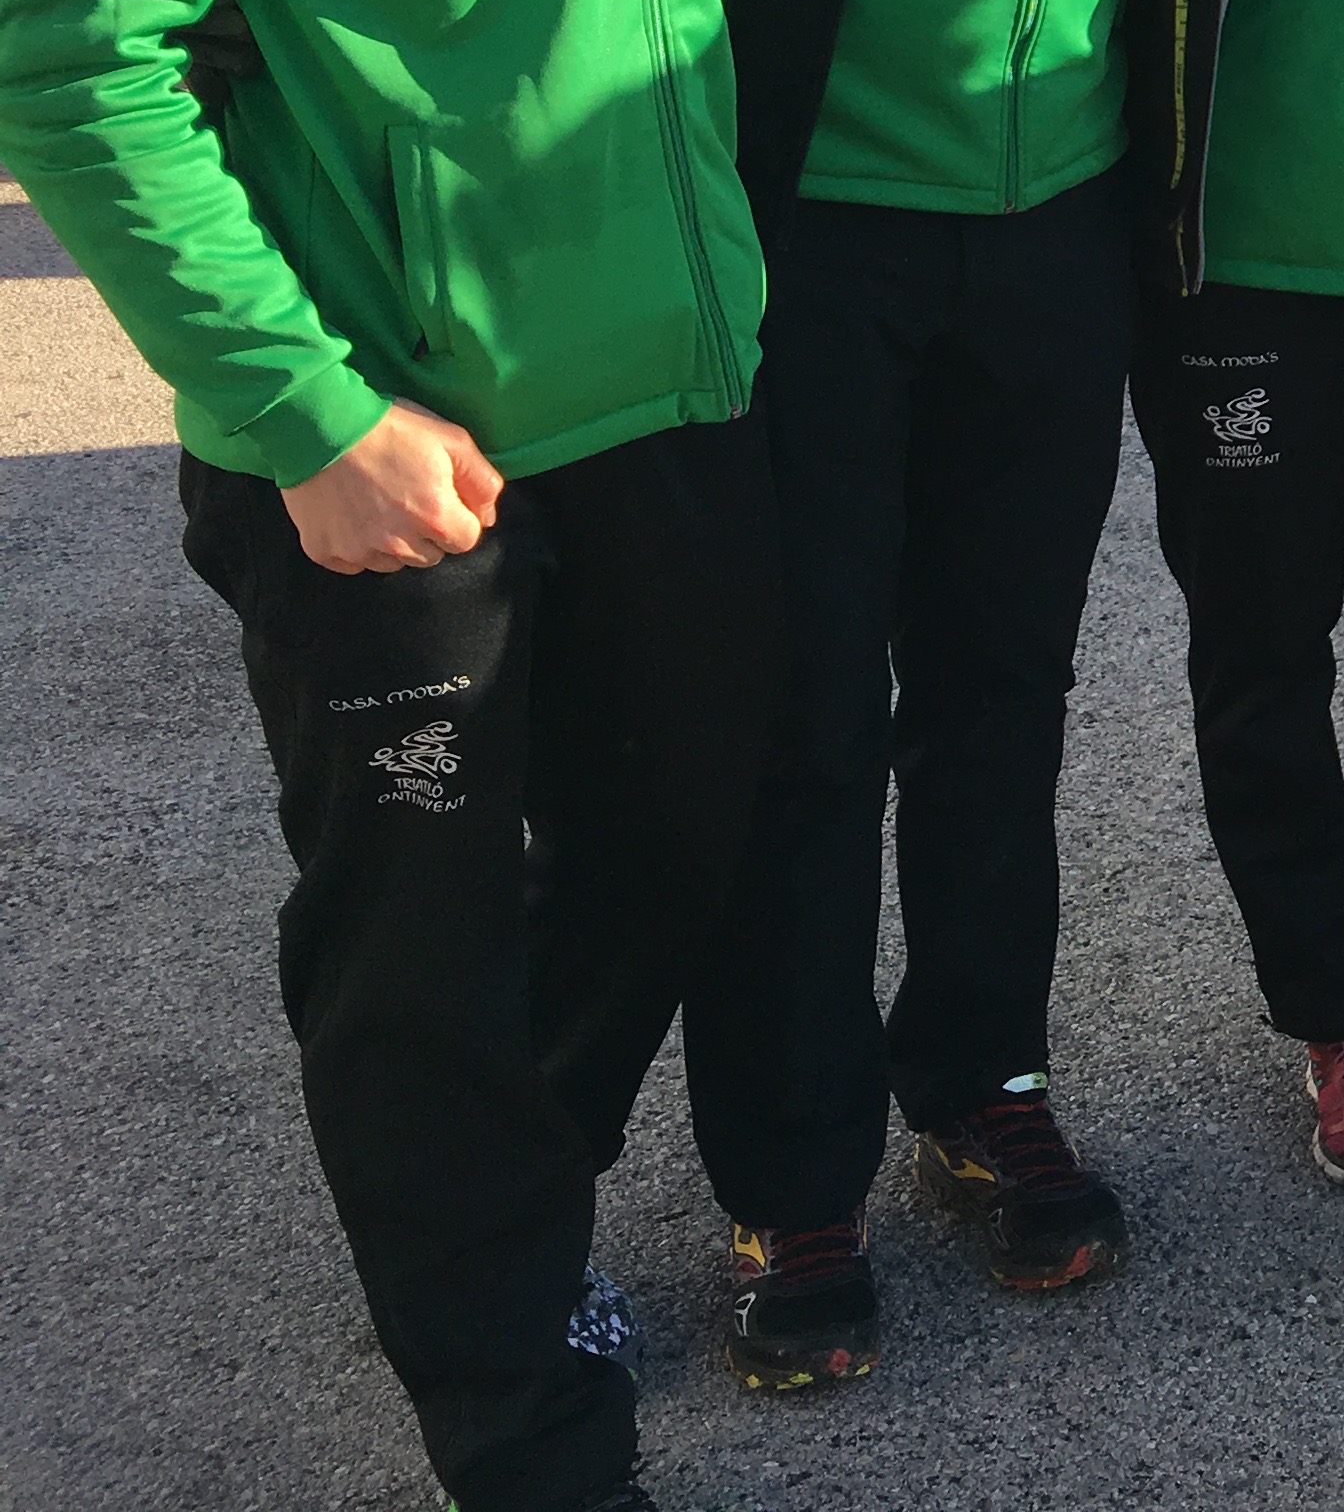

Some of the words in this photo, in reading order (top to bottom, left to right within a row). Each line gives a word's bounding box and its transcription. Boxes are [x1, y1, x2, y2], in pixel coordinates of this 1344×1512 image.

[1181, 354, 1217, 367] CASA
[1221, 351, 1279, 367] MODA'S
[1218, 442, 1263, 458] TRIATLÓ
[1205, 452, 1281, 468] ONTINYENT
[328, 695, 381, 712] CASA
[386, 674, 471, 706] MODA'S
[393, 777, 444, 799] TRIATLÓ
[377, 790, 467, 814] ONTINYENT
